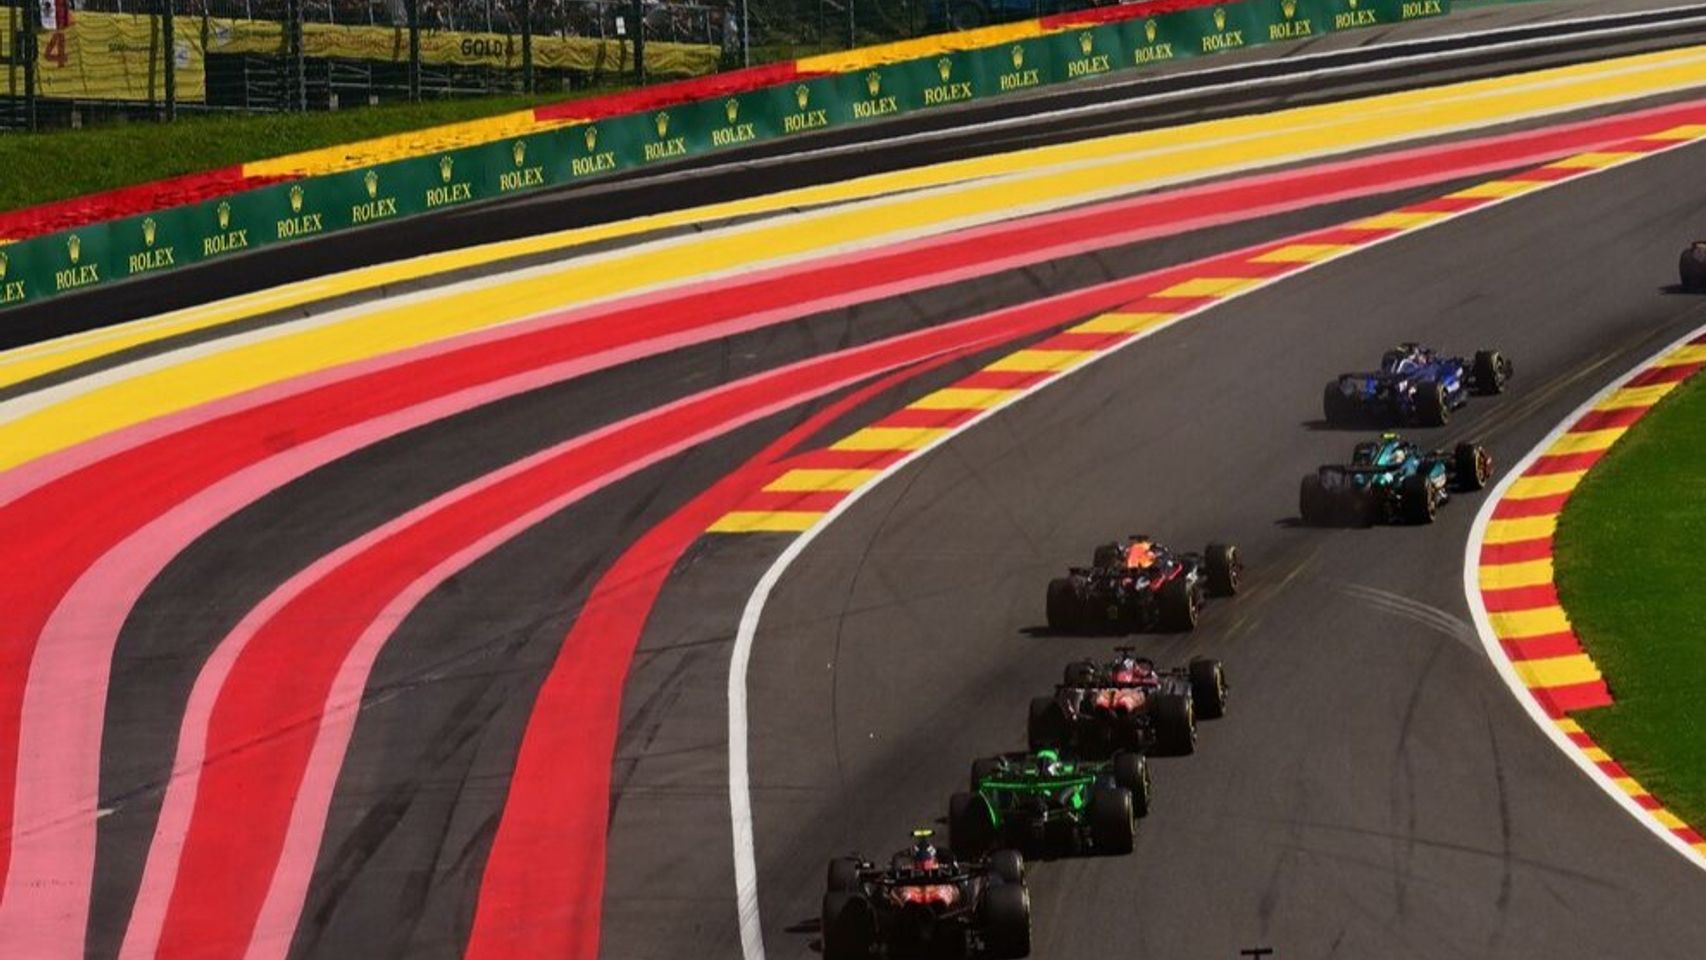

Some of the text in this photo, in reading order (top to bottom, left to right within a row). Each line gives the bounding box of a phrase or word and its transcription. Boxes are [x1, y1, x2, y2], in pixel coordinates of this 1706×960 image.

[1335, 9, 1377, 29] ROLEX
[1402, 0, 1442, 19] ROLEX
[1269, 18, 1311, 39] ROLEX
[44, 32, 69, 68] 4
[461, 38, 502, 57] GOLD
[1202, 30, 1243, 52] ROLEX
[1135, 43, 1173, 65] ROLEX
[1068, 55, 1110, 78] ROLEX
[1000, 68, 1039, 90] ROLEX
[924, 82, 973, 105] ROLEX
[853, 95, 898, 118] ROLEX
[784, 109, 828, 133] ROLEX
[712, 123, 755, 146] ROLEX
[645, 137, 686, 161] ROLEX
[572, 151, 616, 176] ROLEX
[500, 167, 544, 191] ROLEX
[426, 182, 472, 207] ROLEX
[352, 198, 397, 223] ROLEX
[277, 213, 322, 238] ROLEX
[203, 229, 248, 256] ROLEX
[129, 247, 175, 273] ROLEX
[56, 264, 99, 290] ROLEX
